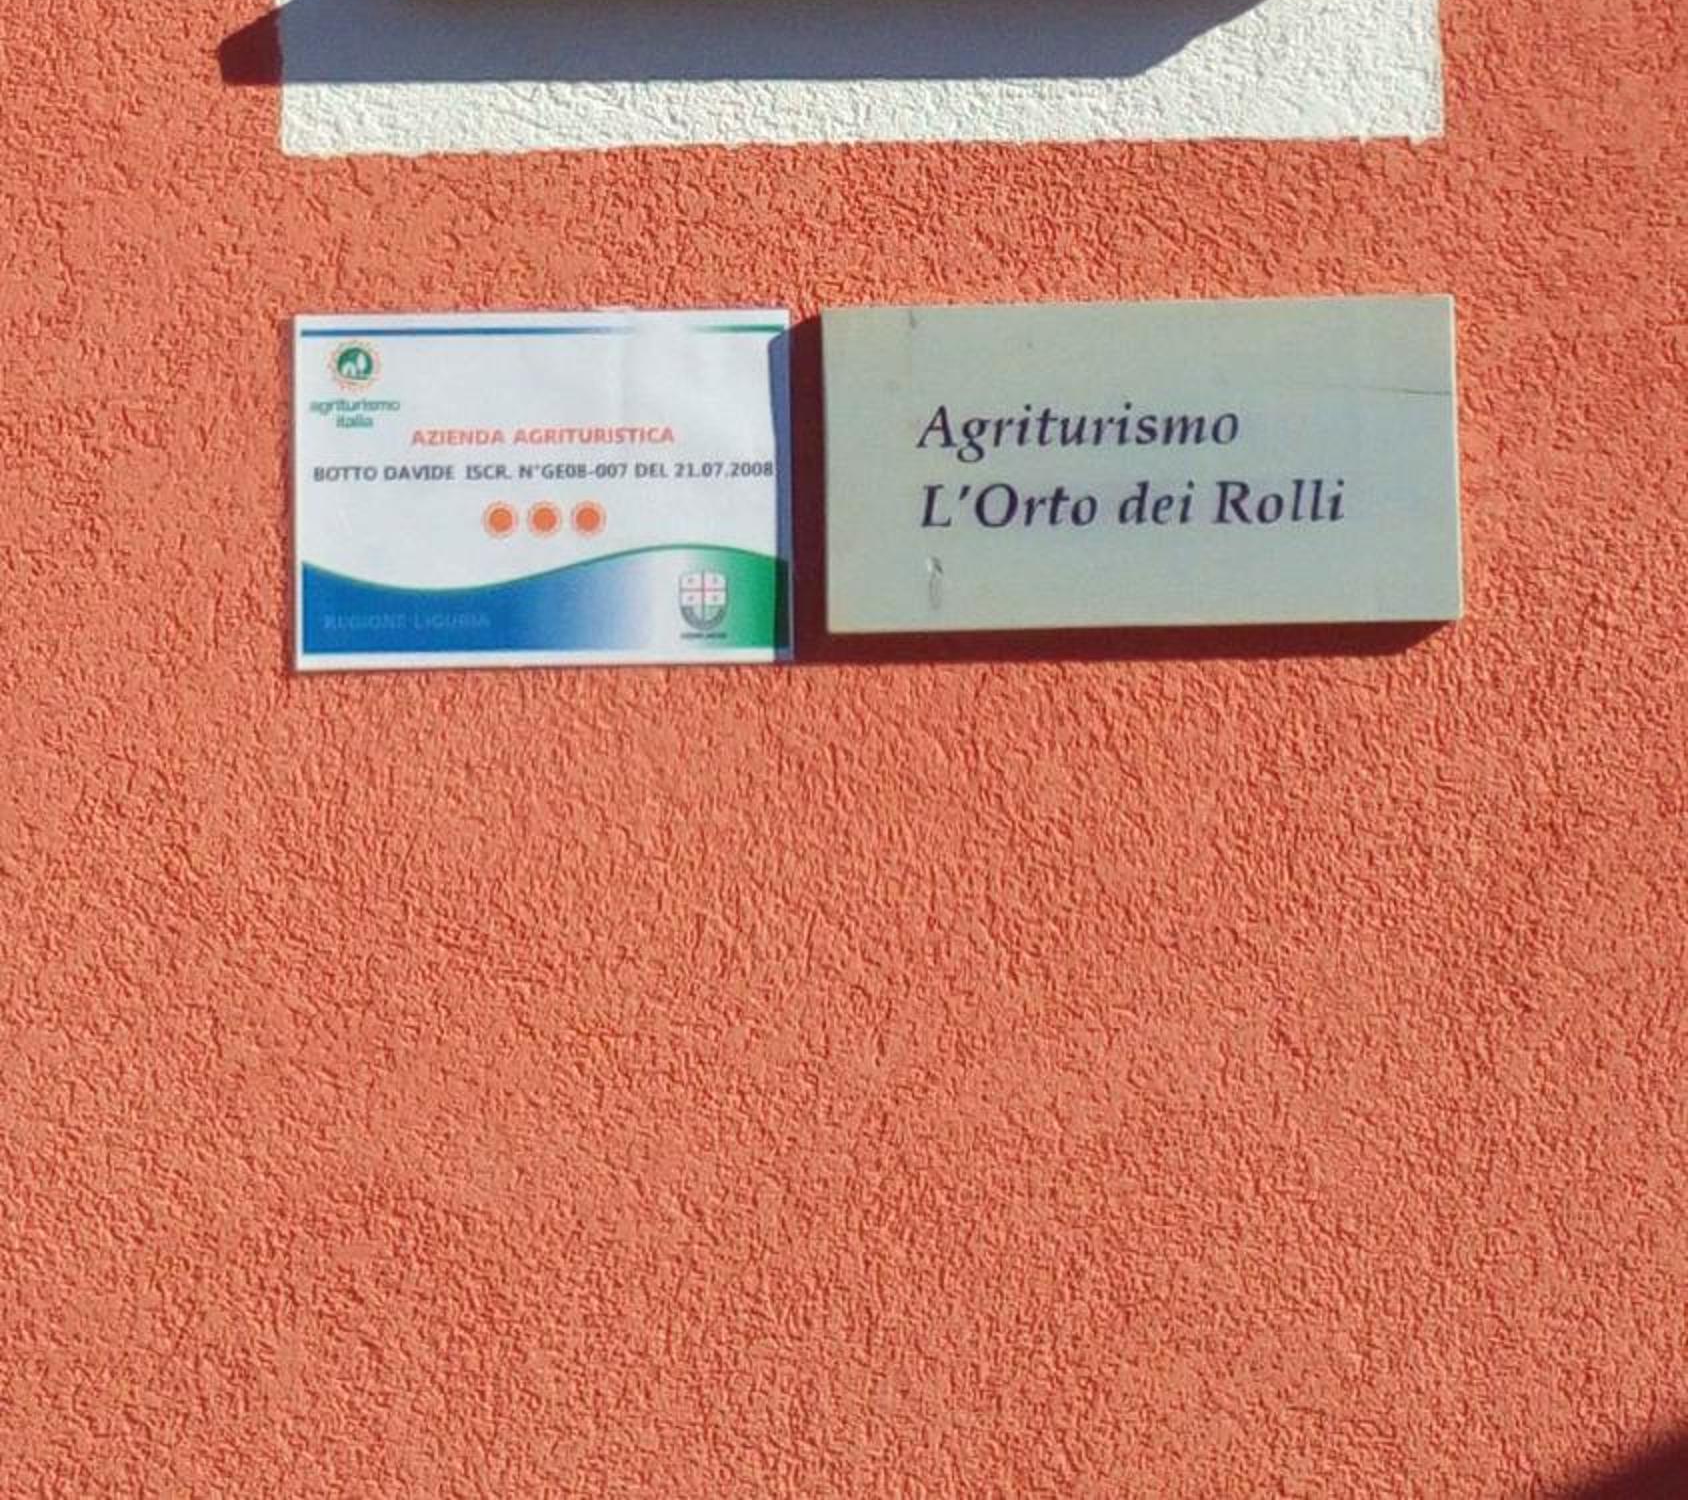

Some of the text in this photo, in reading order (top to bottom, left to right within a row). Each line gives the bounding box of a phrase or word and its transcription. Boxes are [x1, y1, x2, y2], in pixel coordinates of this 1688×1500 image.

[310, 398, 400, 415] agriturismo
[335, 414, 375, 429] italia
[412, 426, 675, 445] AZIENDA AGRITURISTICA
[916, 401, 1241, 463] Agriturismo
[313, 465, 378, 482] BOTTO
[383, 464, 455, 481] DAVIDE
[466, 463, 512, 480] ISCR.
[635, 462, 669, 478] DEL
[674, 460, 774, 478] 21.07.2008
[921, 477, 1346, 528] L'Orto dei Rolli
